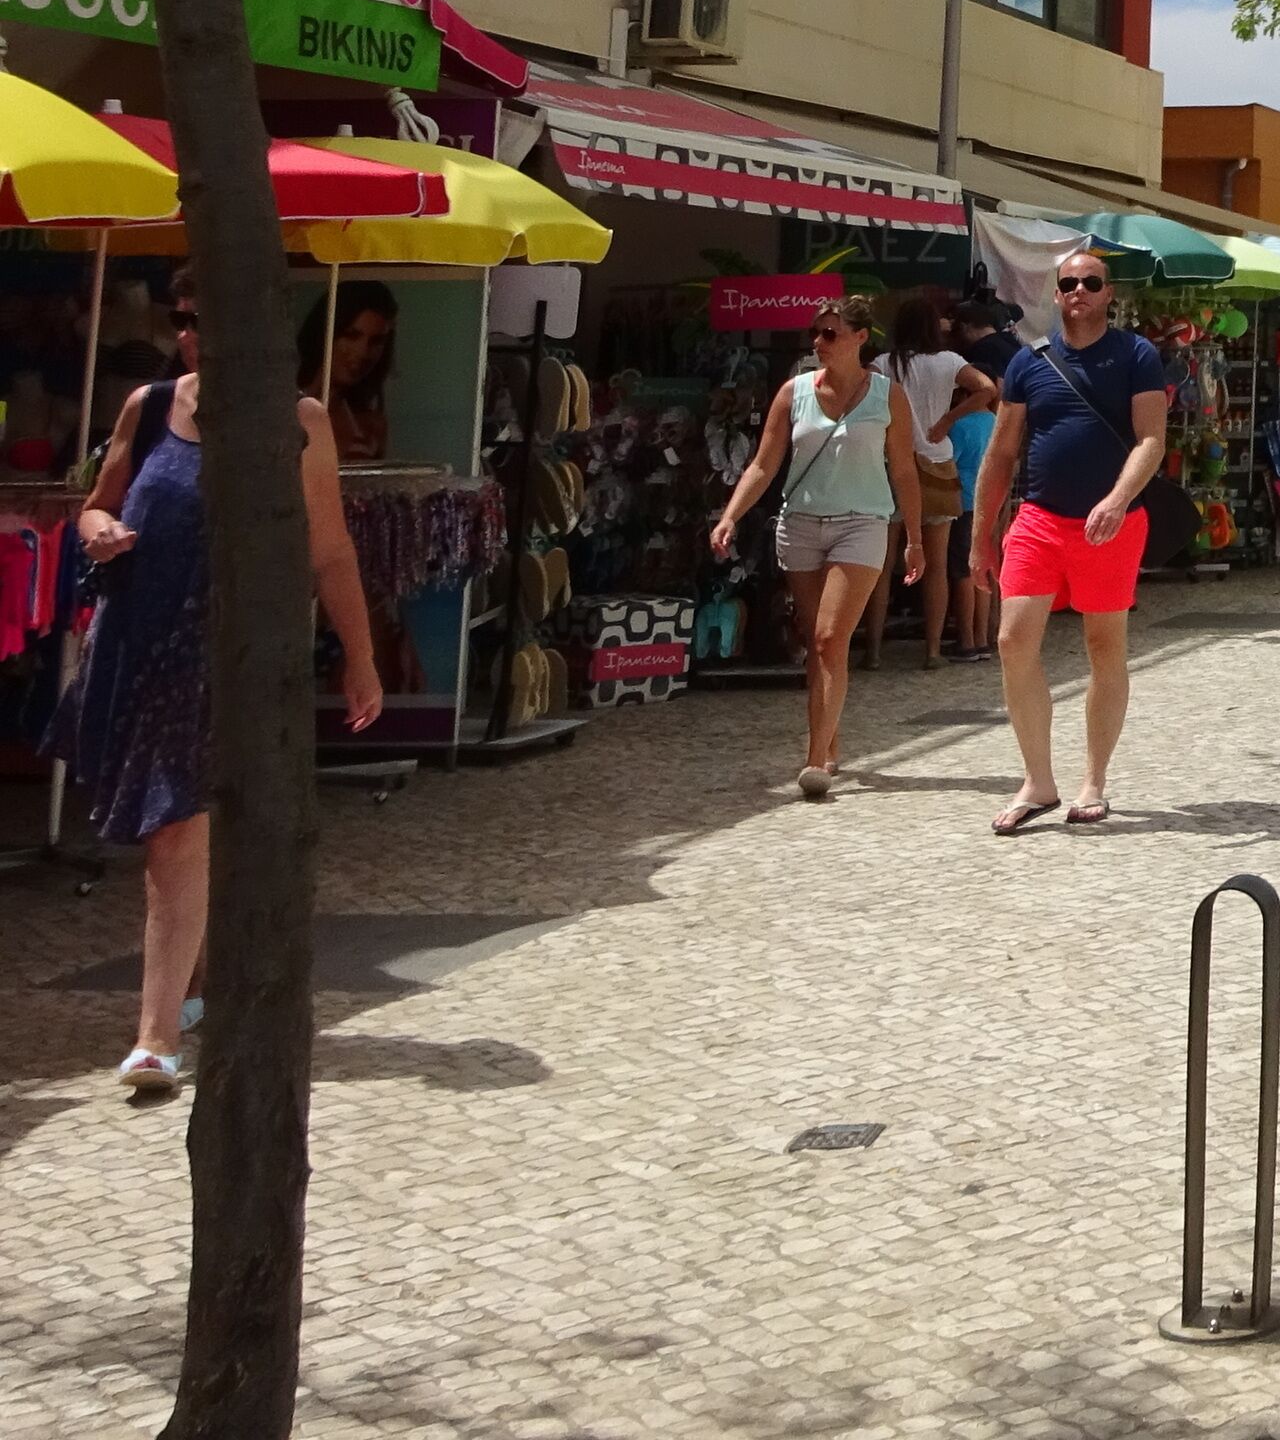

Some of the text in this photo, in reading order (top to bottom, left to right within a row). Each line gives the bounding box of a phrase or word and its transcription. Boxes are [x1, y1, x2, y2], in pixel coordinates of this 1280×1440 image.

[299, 16, 416, 73] BIKINIS
[577, 150, 626, 175] Ipanema
[720, 288, 834, 318] Ipanema
[604, 652, 679, 673] Ipanema
